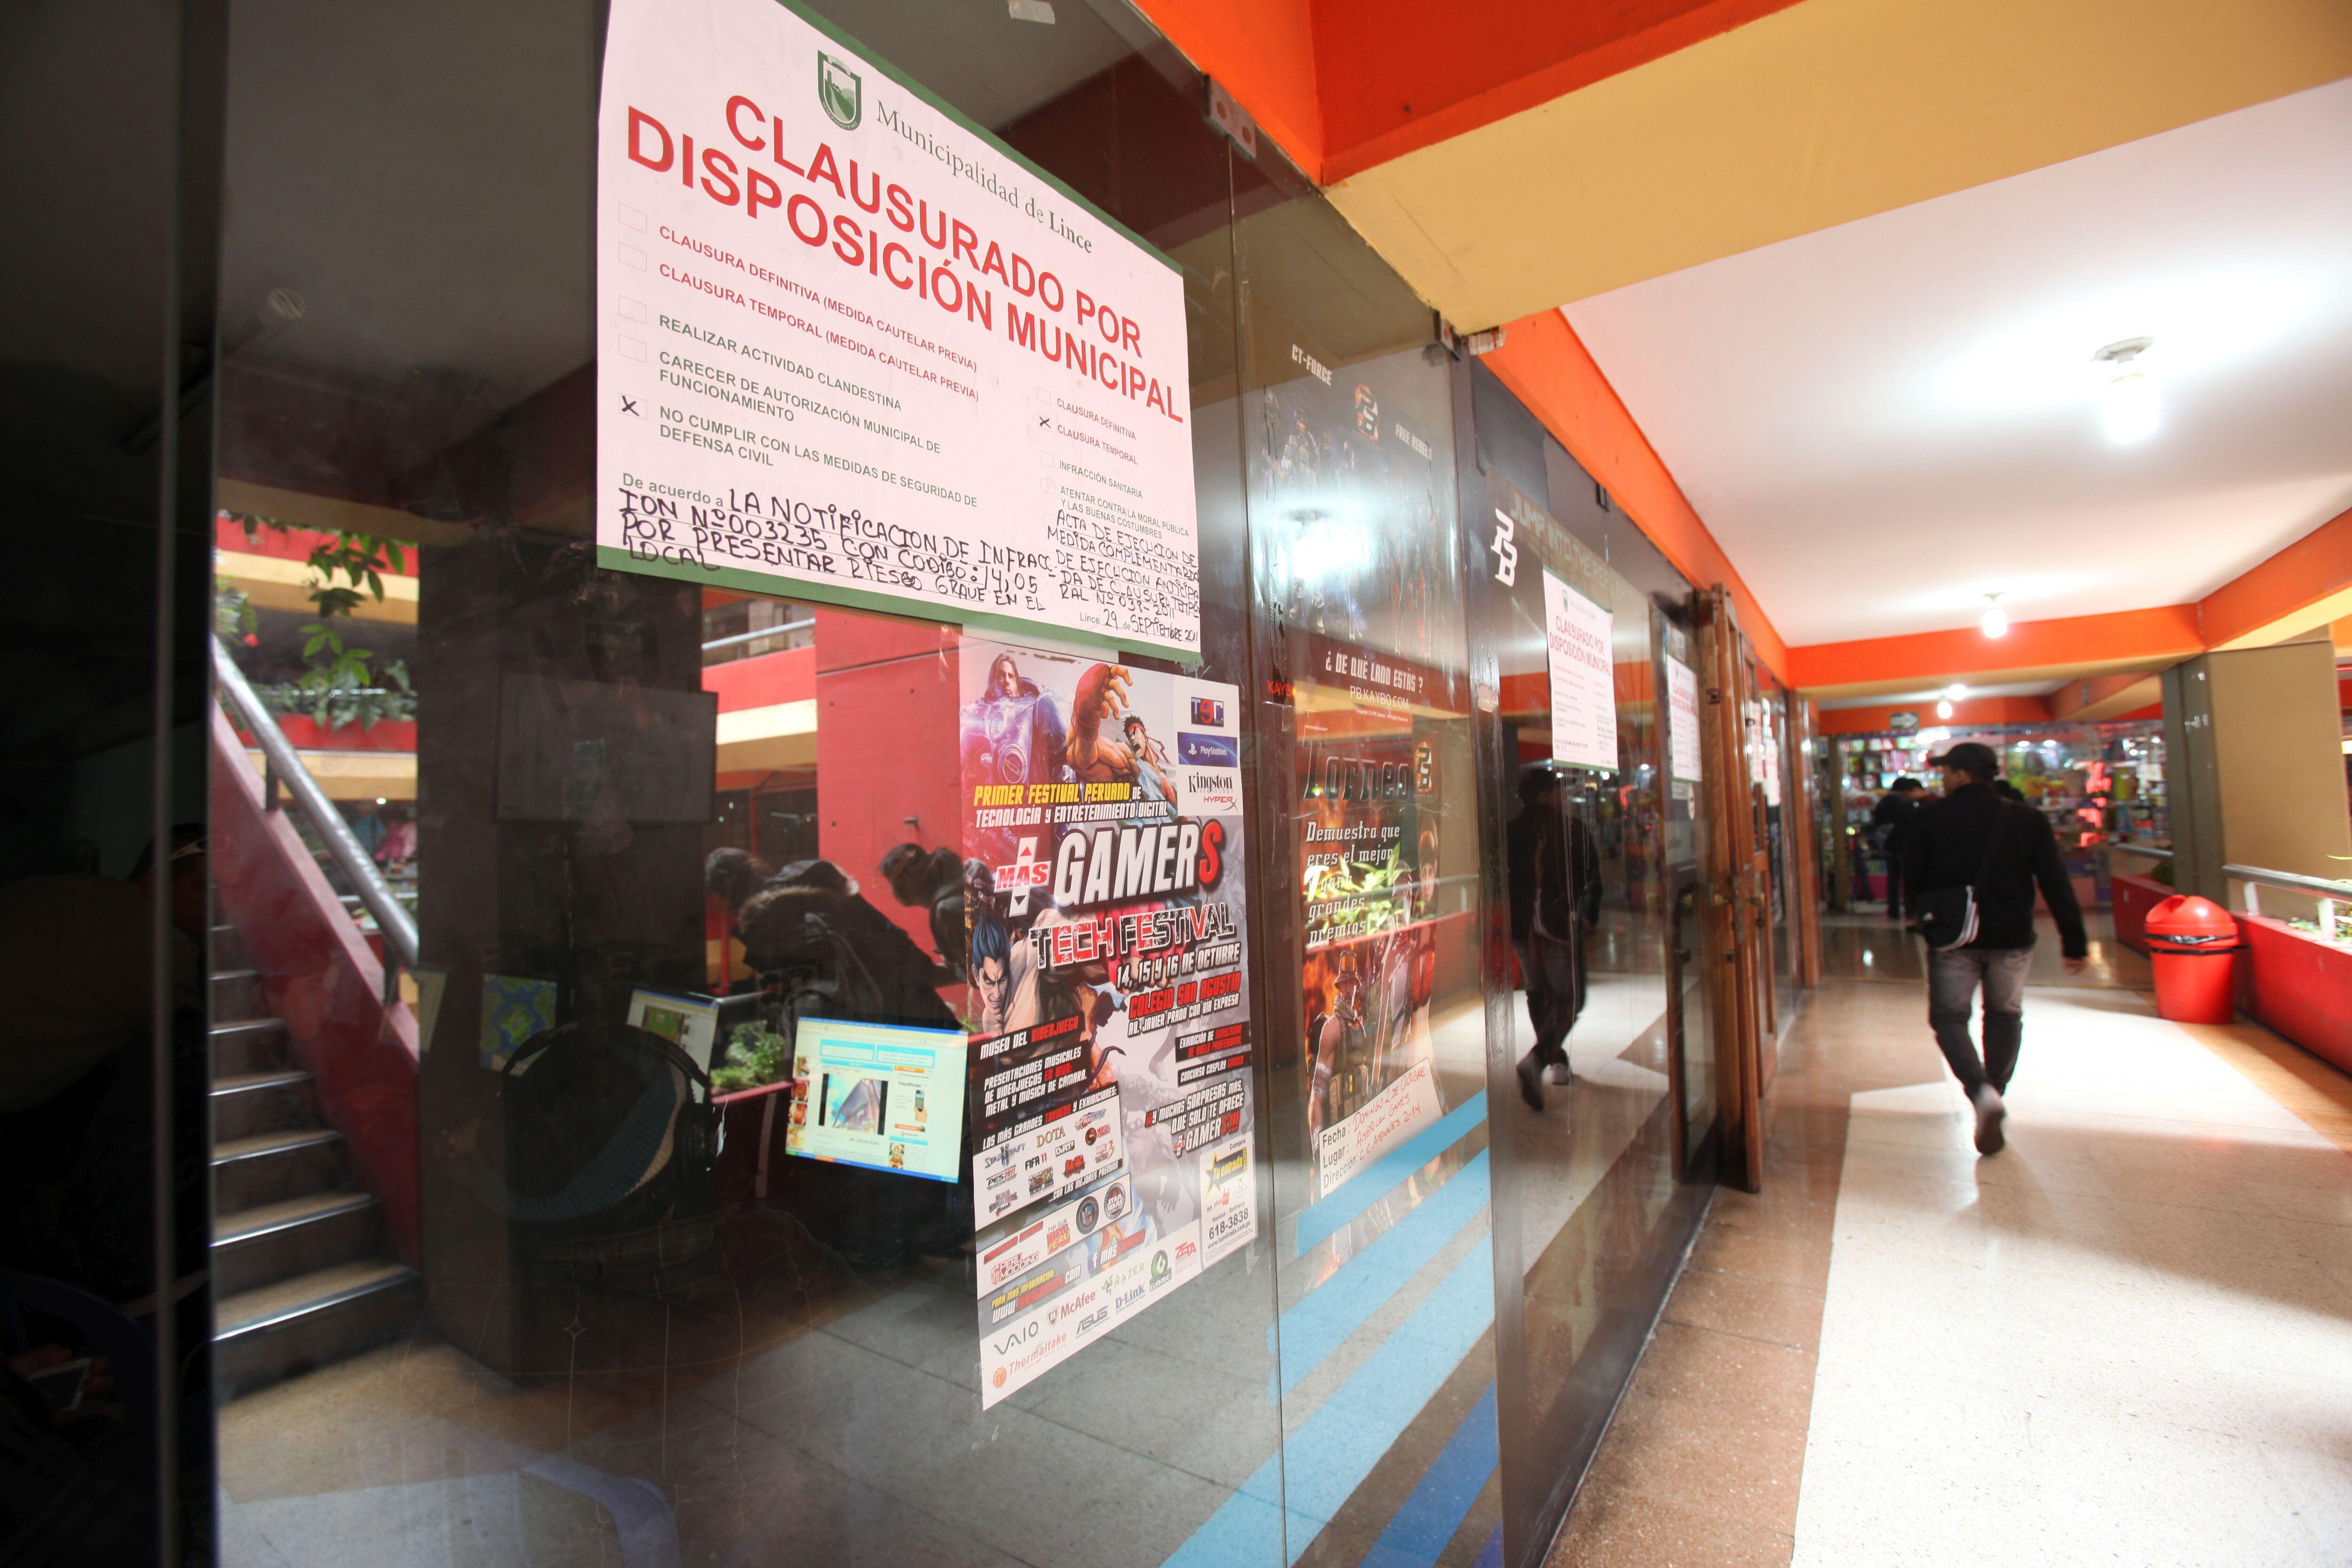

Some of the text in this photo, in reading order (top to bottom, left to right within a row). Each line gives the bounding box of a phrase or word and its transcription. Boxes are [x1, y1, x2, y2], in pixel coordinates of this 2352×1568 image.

[876, 99, 1019, 209] Municipalidad
[1025, 197, 1044, 223] de
[1049, 210, 1092, 254] Lince
[726, 96, 1142, 358] CLAUSURADO POR
[628, 106, 1183, 422] DISPOSICIÓN MUNICIPAL
[660, 226, 977, 373] CLAUSURA DEFINITIVA (MEDIDA CAUTELAR PREVIA)
[660, 264, 979, 403] CLAUSURA TEMPORAL (MEDIDA CAUTELAR PREVIA)
[660, 314, 902, 411] REALIZAR ACTIVIDAD CLANDESTINA
[660, 369, 794, 422] FUNCIONAMIENTO
[660, 351, 940, 454] CARECER DE AUTORIZACIÓN MUNICIPAL DE
[1057, 398, 1136, 440] CLAUSURA DEFINITIVA
[660, 424, 774, 467] DEFENSA CIVIL
[660, 406, 977, 508] NO CUMPLIR CON LAS MEDIDAS DE SEGURIDAD DE
[1057, 424, 1138, 465] CLAUSURA TEMPORAL
[1396, 423, 1432, 461] FREE REBELS
[623, 473, 723, 507] De acuerdo a
[1059, 460, 1143, 499] INFRACCIÓN SANITARIA
[729, 488, 761, 514] LA
[942, 536, 969, 565] DE
[1061, 486, 1189, 537] ATENTAR CONTRA LA MORAL PÚBLICA
[1061, 498, 1162, 539] Y LAS BUENAS COSTUMBRES
[627, 535, 721, 571] LOCAL
[1057, 509, 1197, 568] ACTA DE EJECUCION DE
[1104, 608, 1118, 631] 29
[1123, 621, 1131, 630] de
[1335, 652, 1416, 692] DE QUÉ LADO ESTÁS
[1350, 685, 1409, 710] PB.KAYBO.COM
[1200, 745, 1227, 757] PlayStation
[974, 782, 1142, 806] PRIMER FESTIVAL PERUANO DE
[1188, 771, 1233, 794] Kingston
[975, 804, 1041, 828] TECNOLOGÍA
[1054, 802, 1136, 823] ENTRETENIMIENTO
[1137, 801, 1168, 818] DIGITAL
[1305, 821, 1400, 843] Demuestra que
[996, 821, 1222, 907] MAS GAMERS
[1307, 844, 1392, 867] eres el mejor
[1308, 895, 1365, 924] grandes
[1029, 902, 1235, 970] TECH FESTIVAL
[1310, 919, 1366, 946] premios
[1117, 964, 1132, 988] 14,
[1138, 960, 1152, 984] 15
[1166, 955, 1179, 978] 16
[1181, 951, 1195, 974] DE
[1197, 941, 1241, 970] OCTUBRE
[1128, 993, 1240, 1037] AV. JAVIER PRADO CON VÍA EXPRESA
[1129, 987, 1175, 1019] COLEGIO
[1177, 981, 1198, 1006] SAN
[980, 1016, 1080, 1060] MUSEO DEL VIDEOJUEGO
[984, 1046, 1082, 1091] PRESENTACIONES MUSICALES
[1180, 1064, 1205, 1083] CONCURSO
[1206, 1059, 1226, 1075] COSPLAY
[1159, 1099, 1186, 1122] MUCHAS
[1186, 1082, 1227, 1111] SORPRESAS
[1036, 1125, 1066, 1148] DOTA
[1025, 1152, 1047, 1170] FIFA 11
[1324, 1154, 1358, 1189] Dirección:
[1209, 1207, 1249, 1240] 618-3838
[1212, 1201, 1245, 1223] Ventas Delivery
[1060, 1290, 1097, 1320] McAfee
[994, 1321, 1039, 1355] VAIO
[1009, 1332, 1067, 1375] Thermaltake
